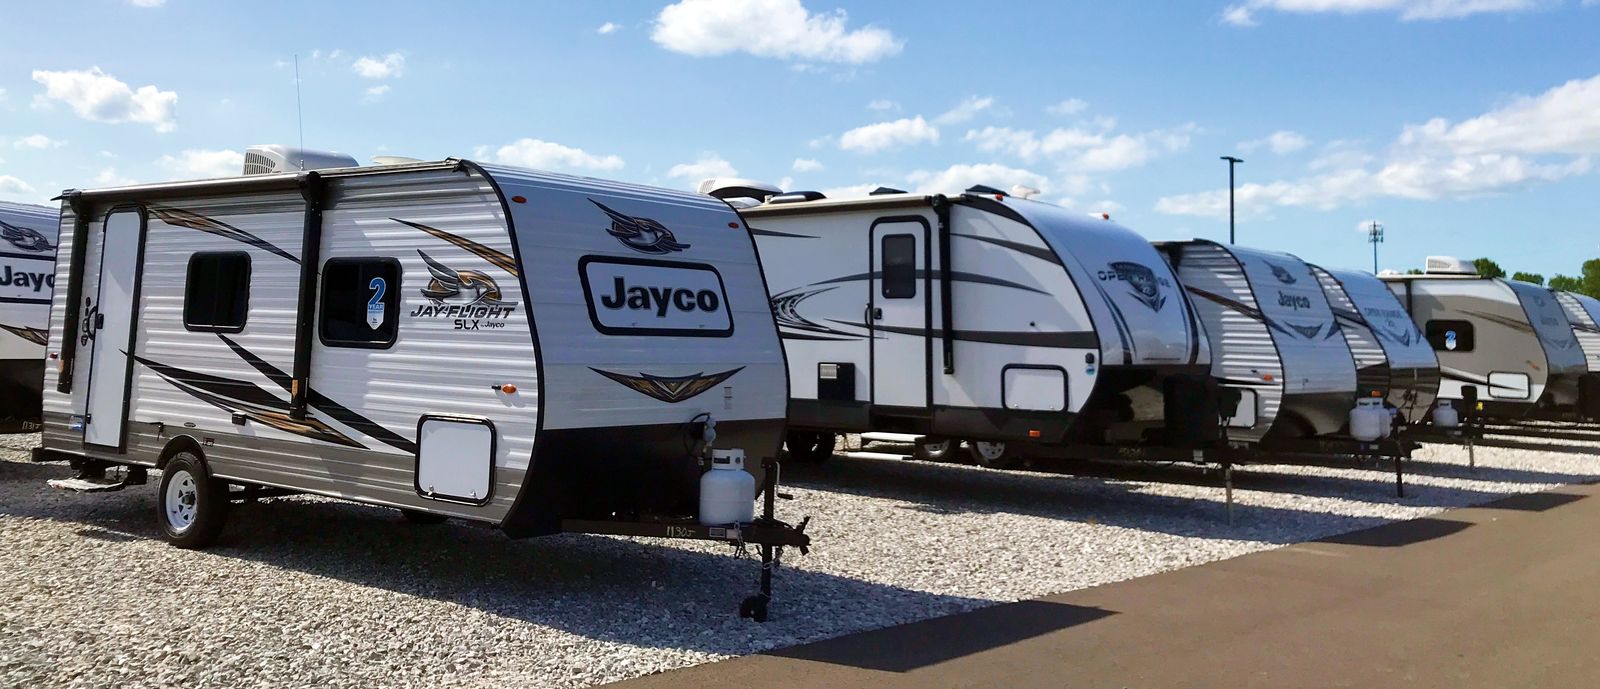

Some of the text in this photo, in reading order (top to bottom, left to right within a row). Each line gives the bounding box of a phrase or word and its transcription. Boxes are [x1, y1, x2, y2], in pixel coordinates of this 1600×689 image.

[368, 277, 386, 305] 2
[601, 276, 719, 317] Jayco
[1278, 290, 1310, 311] Jayco
[454, 319, 479, 330] SLX
[485, 321, 505, 329] Jayco
